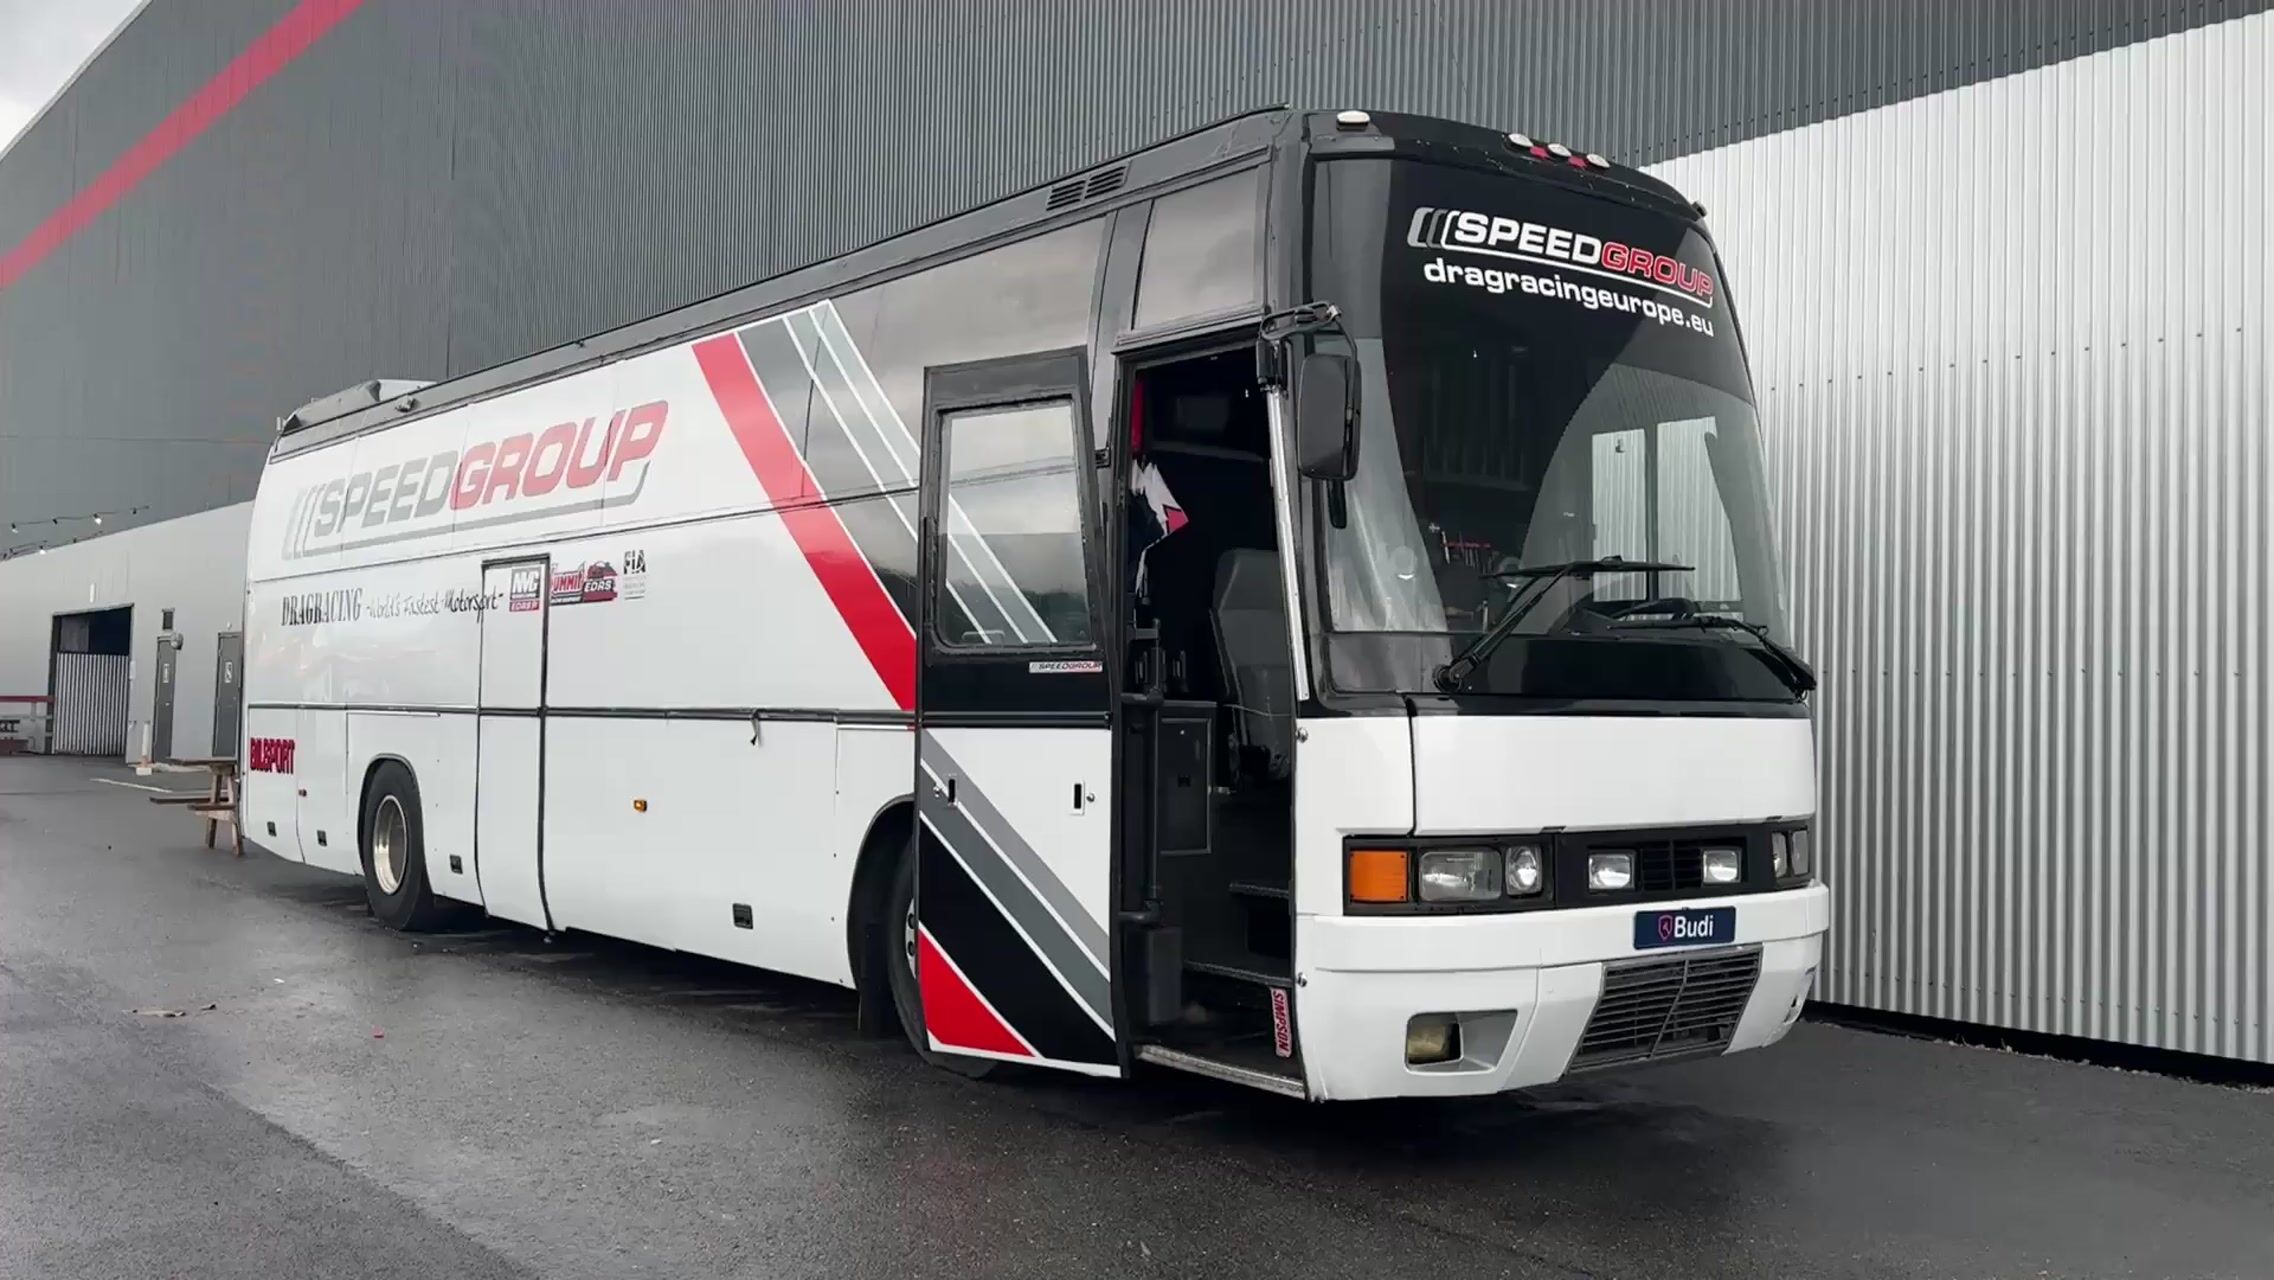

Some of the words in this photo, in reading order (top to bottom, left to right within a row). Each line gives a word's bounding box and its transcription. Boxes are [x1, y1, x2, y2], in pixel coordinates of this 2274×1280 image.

[1454, 211, 1714, 297] SPEEDGROUP
[1423, 257, 1714, 337] dragracingeurope.eu
[315, 400, 668, 537] SPEEDGROUP
[281, 588, 362, 626] DRAGRACING
[250, 737, 295, 775] BILSPORT
[1674, 915, 1714, 938] Budi
[1273, 990, 1290, 1052] SIMPSON
